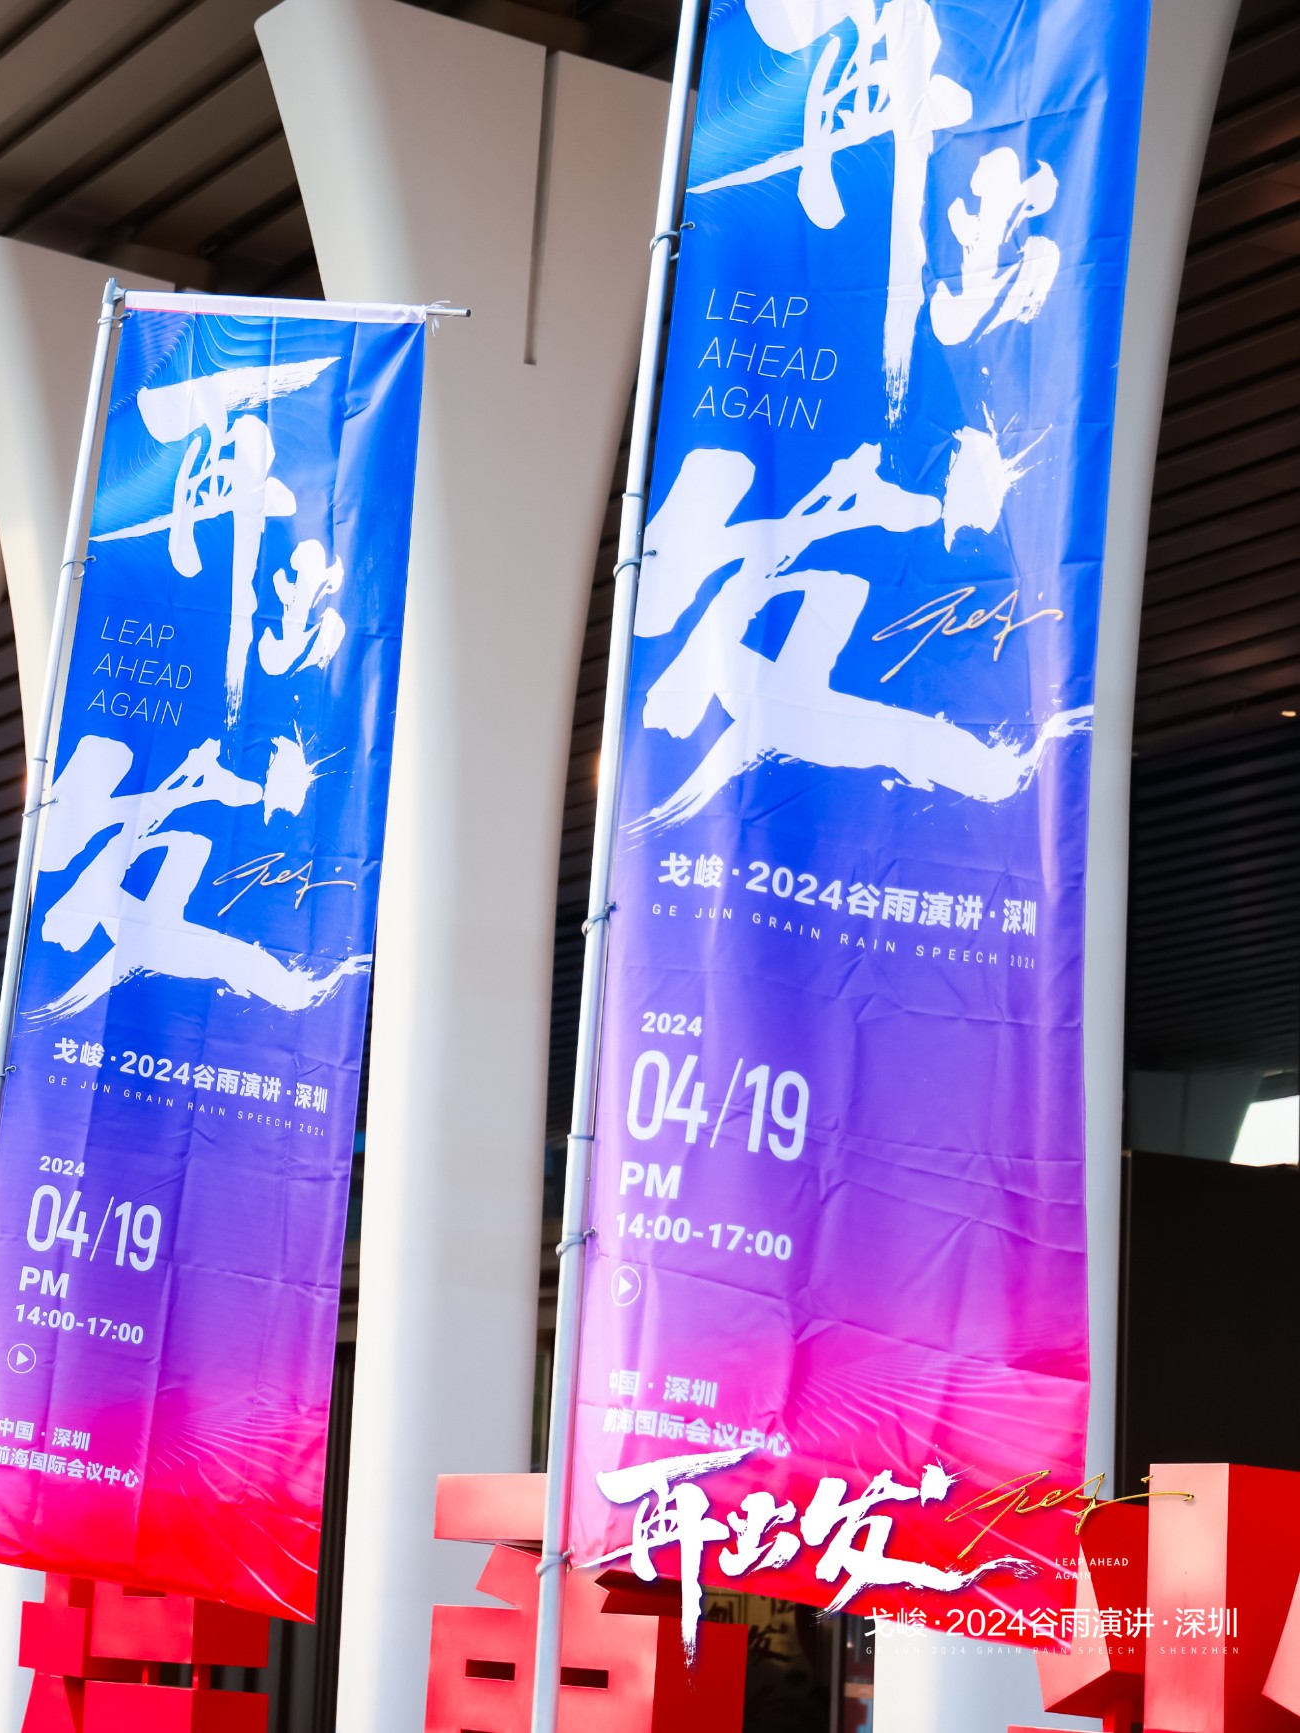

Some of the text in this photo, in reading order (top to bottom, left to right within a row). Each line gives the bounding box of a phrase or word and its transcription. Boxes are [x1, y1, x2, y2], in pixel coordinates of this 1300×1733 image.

[705, 288, 809, 330] LEAP
[698, 336, 838, 383] AHEAD
[692, 385, 822, 431] AGAIN
[100, 616, 175, 649] LEAP
[92, 652, 193, 691] AHEAD
[87, 689, 183, 727] AGAIN
[651, 902, 1035, 970] GE JUN GRAIN RAIN SPEECH 2024
[641, 1011, 702, 1037] 2024
[52, 1036, 329, 1115] 戈峻·2024谷雨演讲·深圳
[47, 1074, 68, 1087] GE
[79, 1079, 111, 1094] JUN
[123, 1089, 175, 1108] GRAIN
[187, 1101, 226, 1117] RAIN
[237, 1110, 292, 1130] SPEECH
[625, 1049, 810, 1162] 04/19
[38, 1155, 85, 1178] 2024
[618, 1160, 682, 1200] PM
[25, 1184, 162, 1272] 04/19
[614, 1211, 793, 1261] 14:00-17:00
[18, 1265, 70, 1299] PM
[14, 1304, 145, 1345] 14:00-17:00
